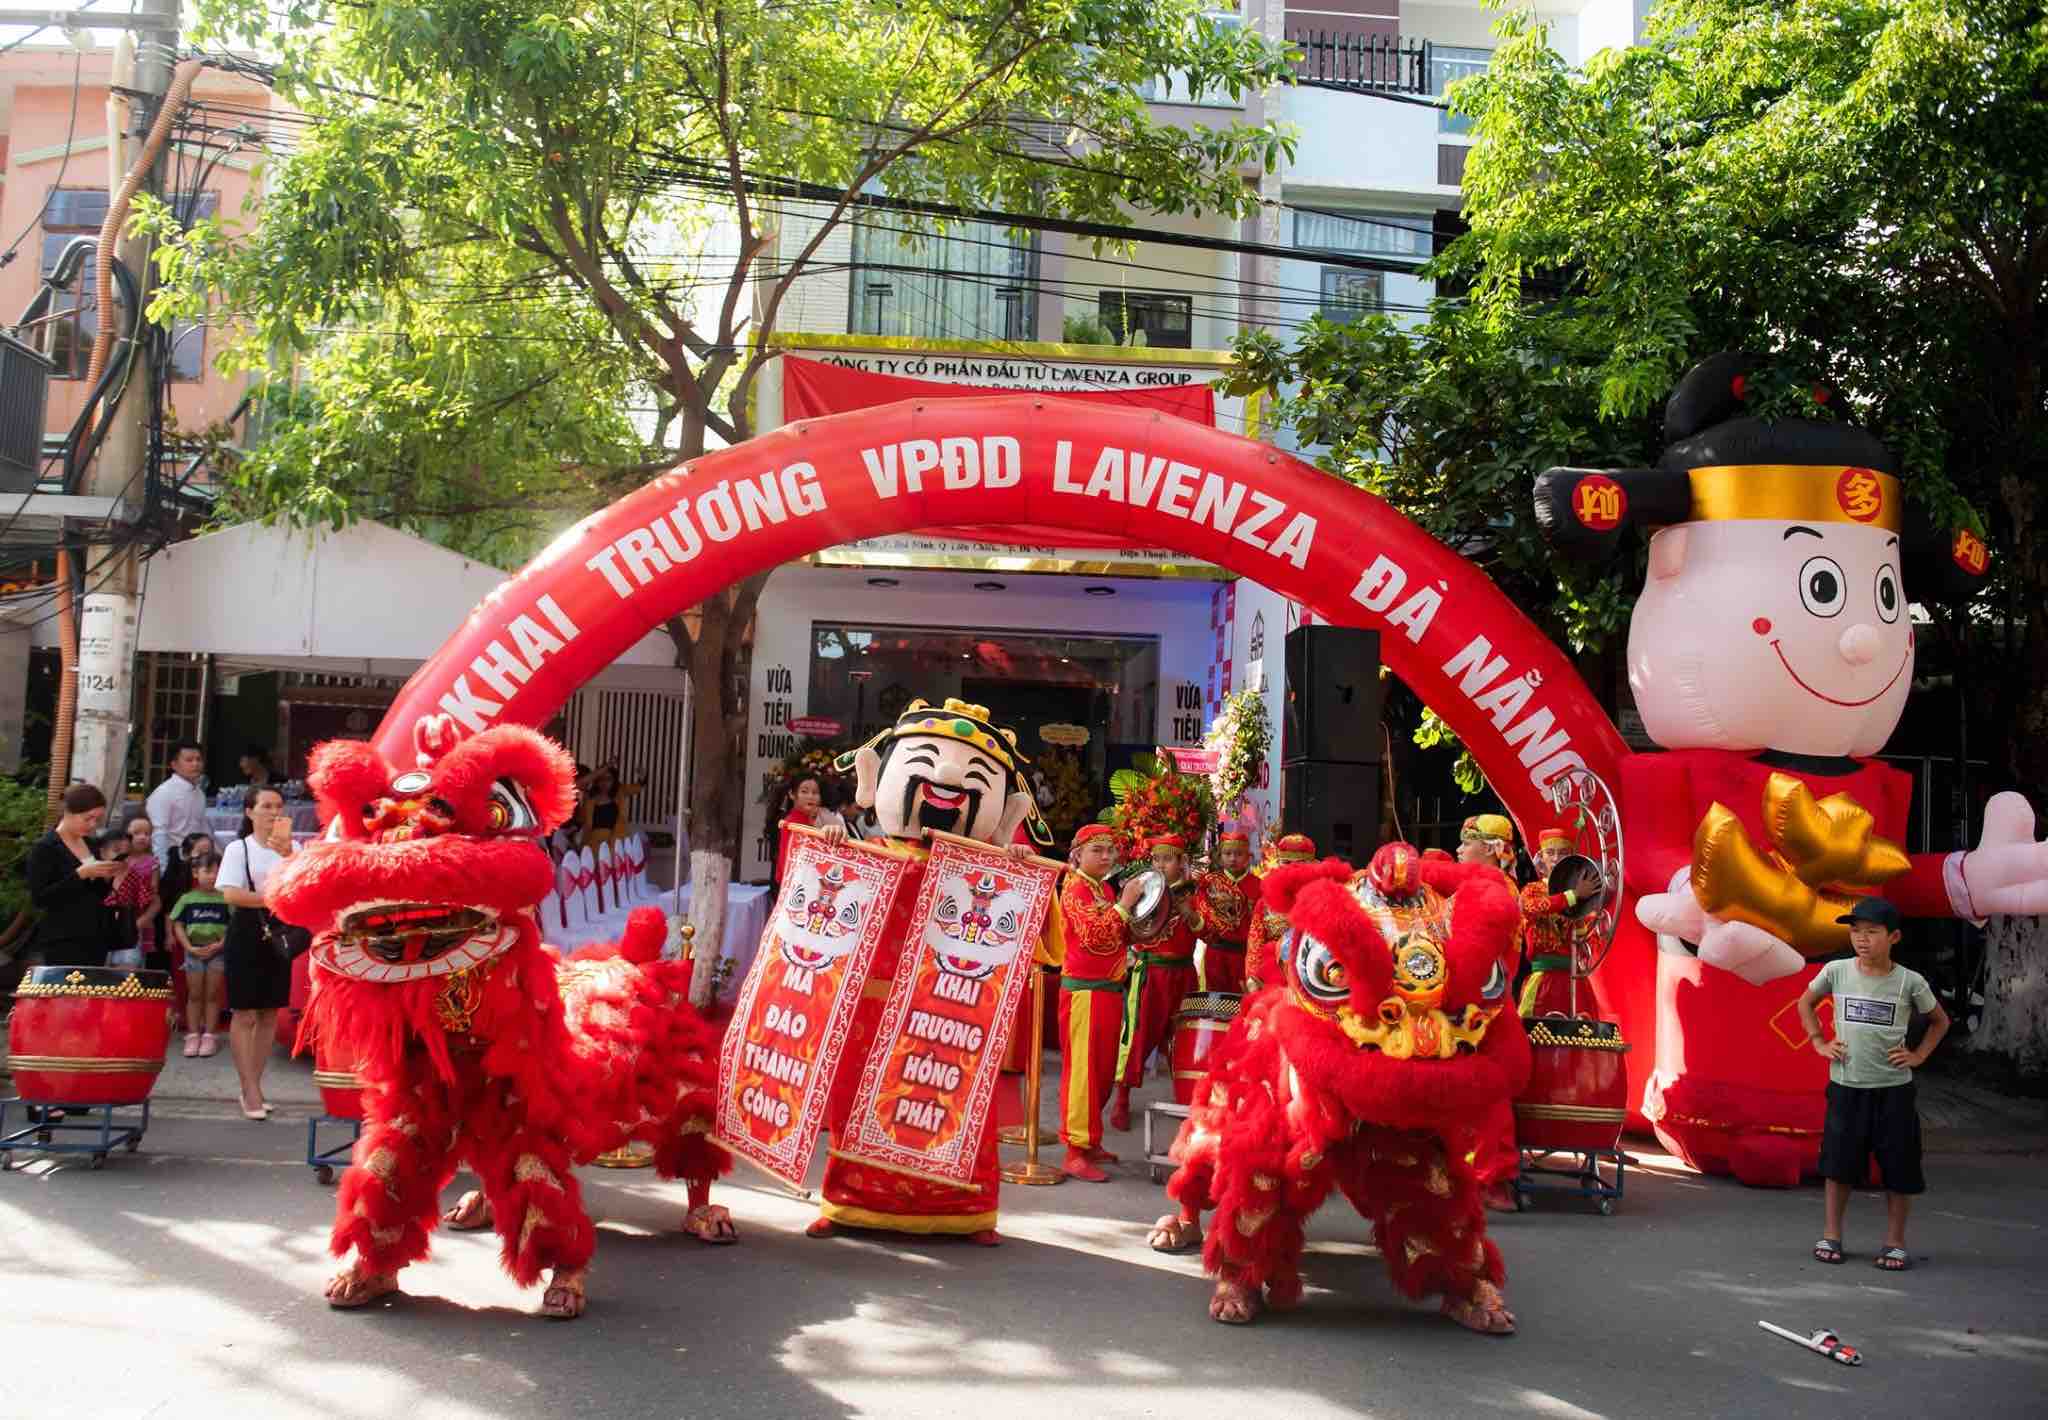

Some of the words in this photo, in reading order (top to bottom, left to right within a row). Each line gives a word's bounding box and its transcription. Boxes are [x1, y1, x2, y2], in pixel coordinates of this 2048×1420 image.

[877, 360, 899, 375] TY
[1052, 367, 1130, 385] LAVENZA
[1135, 370, 1193, 386] GROUP
[439, 594, 581, 734] KHAI
[586, 461, 828, 600] TRƯƠNG
[861, 436, 1021, 499] VPĐD
[1053, 440, 1318, 570] LAVENZA
[1350, 553, 1449, 644] ĐÀ
[1441, 634, 1590, 802] NẴNG
[766, 664, 792, 694] VỪA
[1176, 680, 1201, 710] VỪA
[933, 972, 982, 1006] KHAI
[895, 1099, 946, 1134] PHÁT
